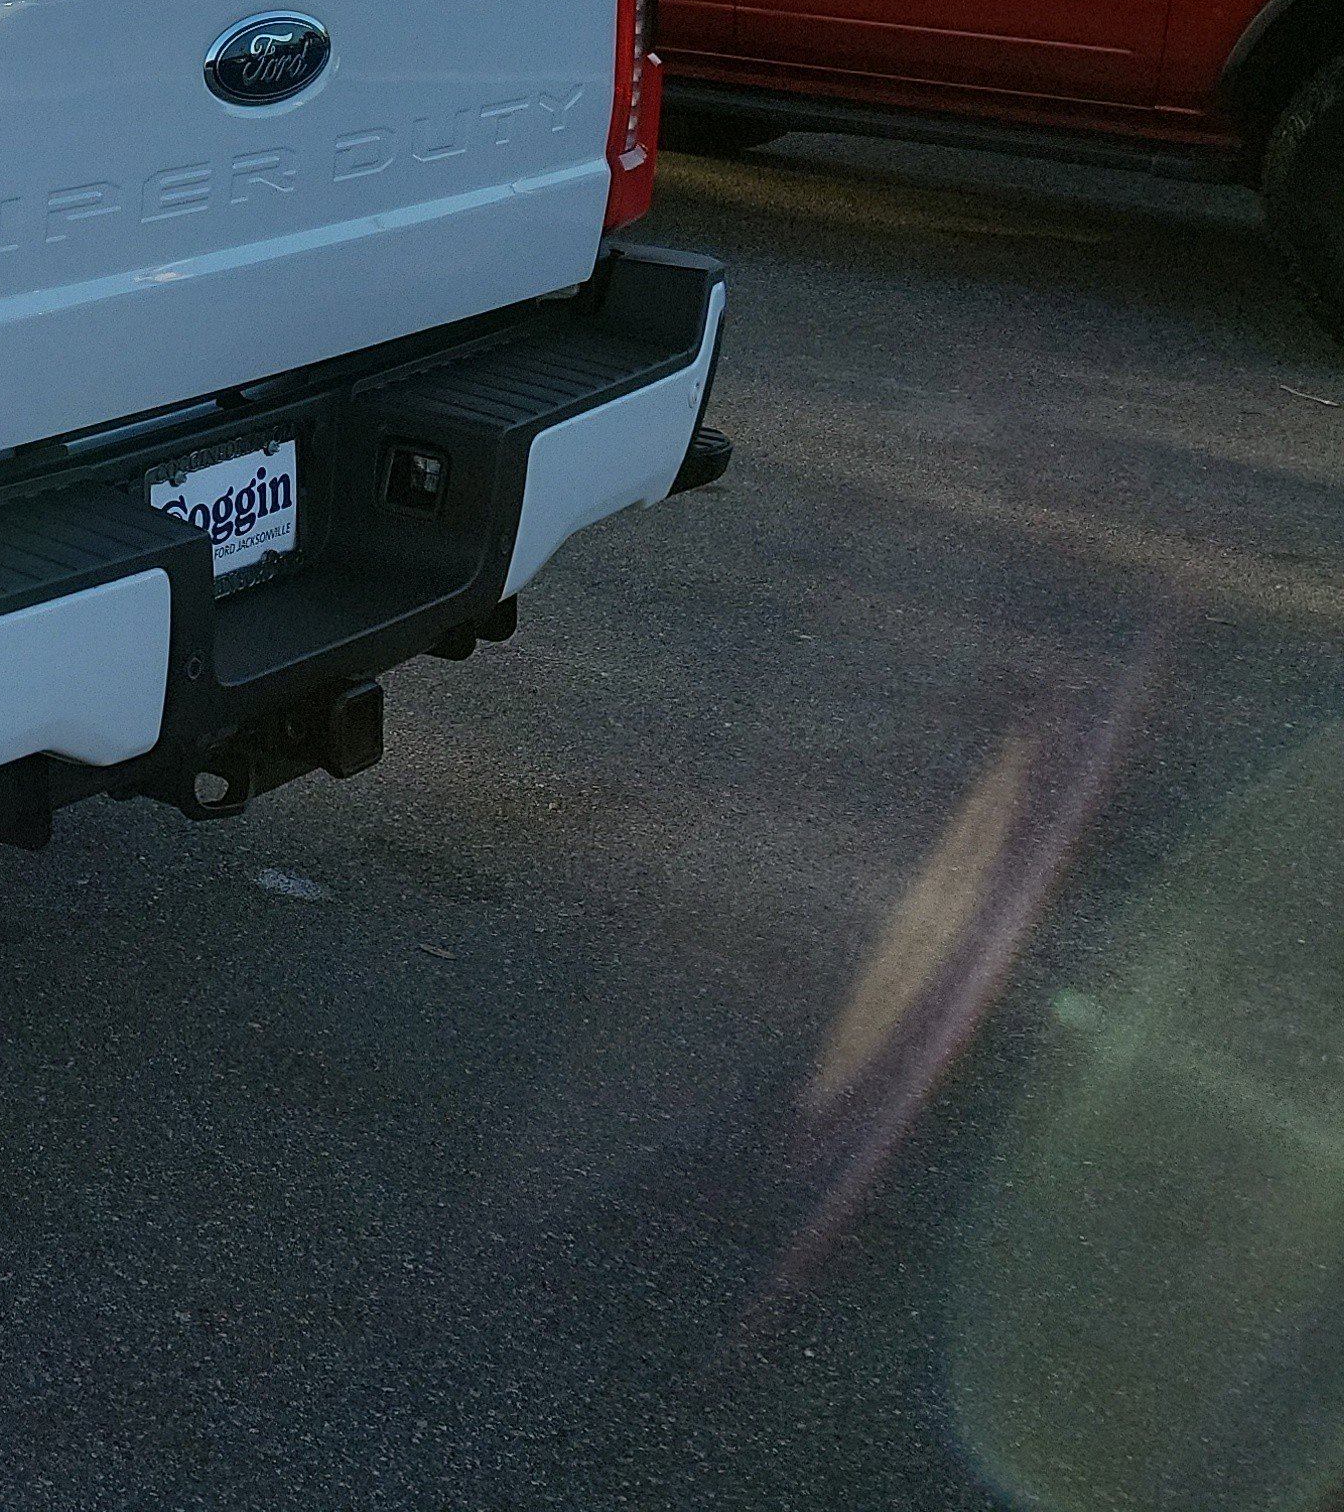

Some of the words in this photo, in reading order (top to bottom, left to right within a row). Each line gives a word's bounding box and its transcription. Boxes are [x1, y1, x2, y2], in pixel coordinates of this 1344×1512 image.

[242, 32, 309, 86] Ford
[332, 90, 583, 183] DUTY
[214, 543, 236, 559] FORD
[236, 522, 291, 552] JACKSONVILLE
